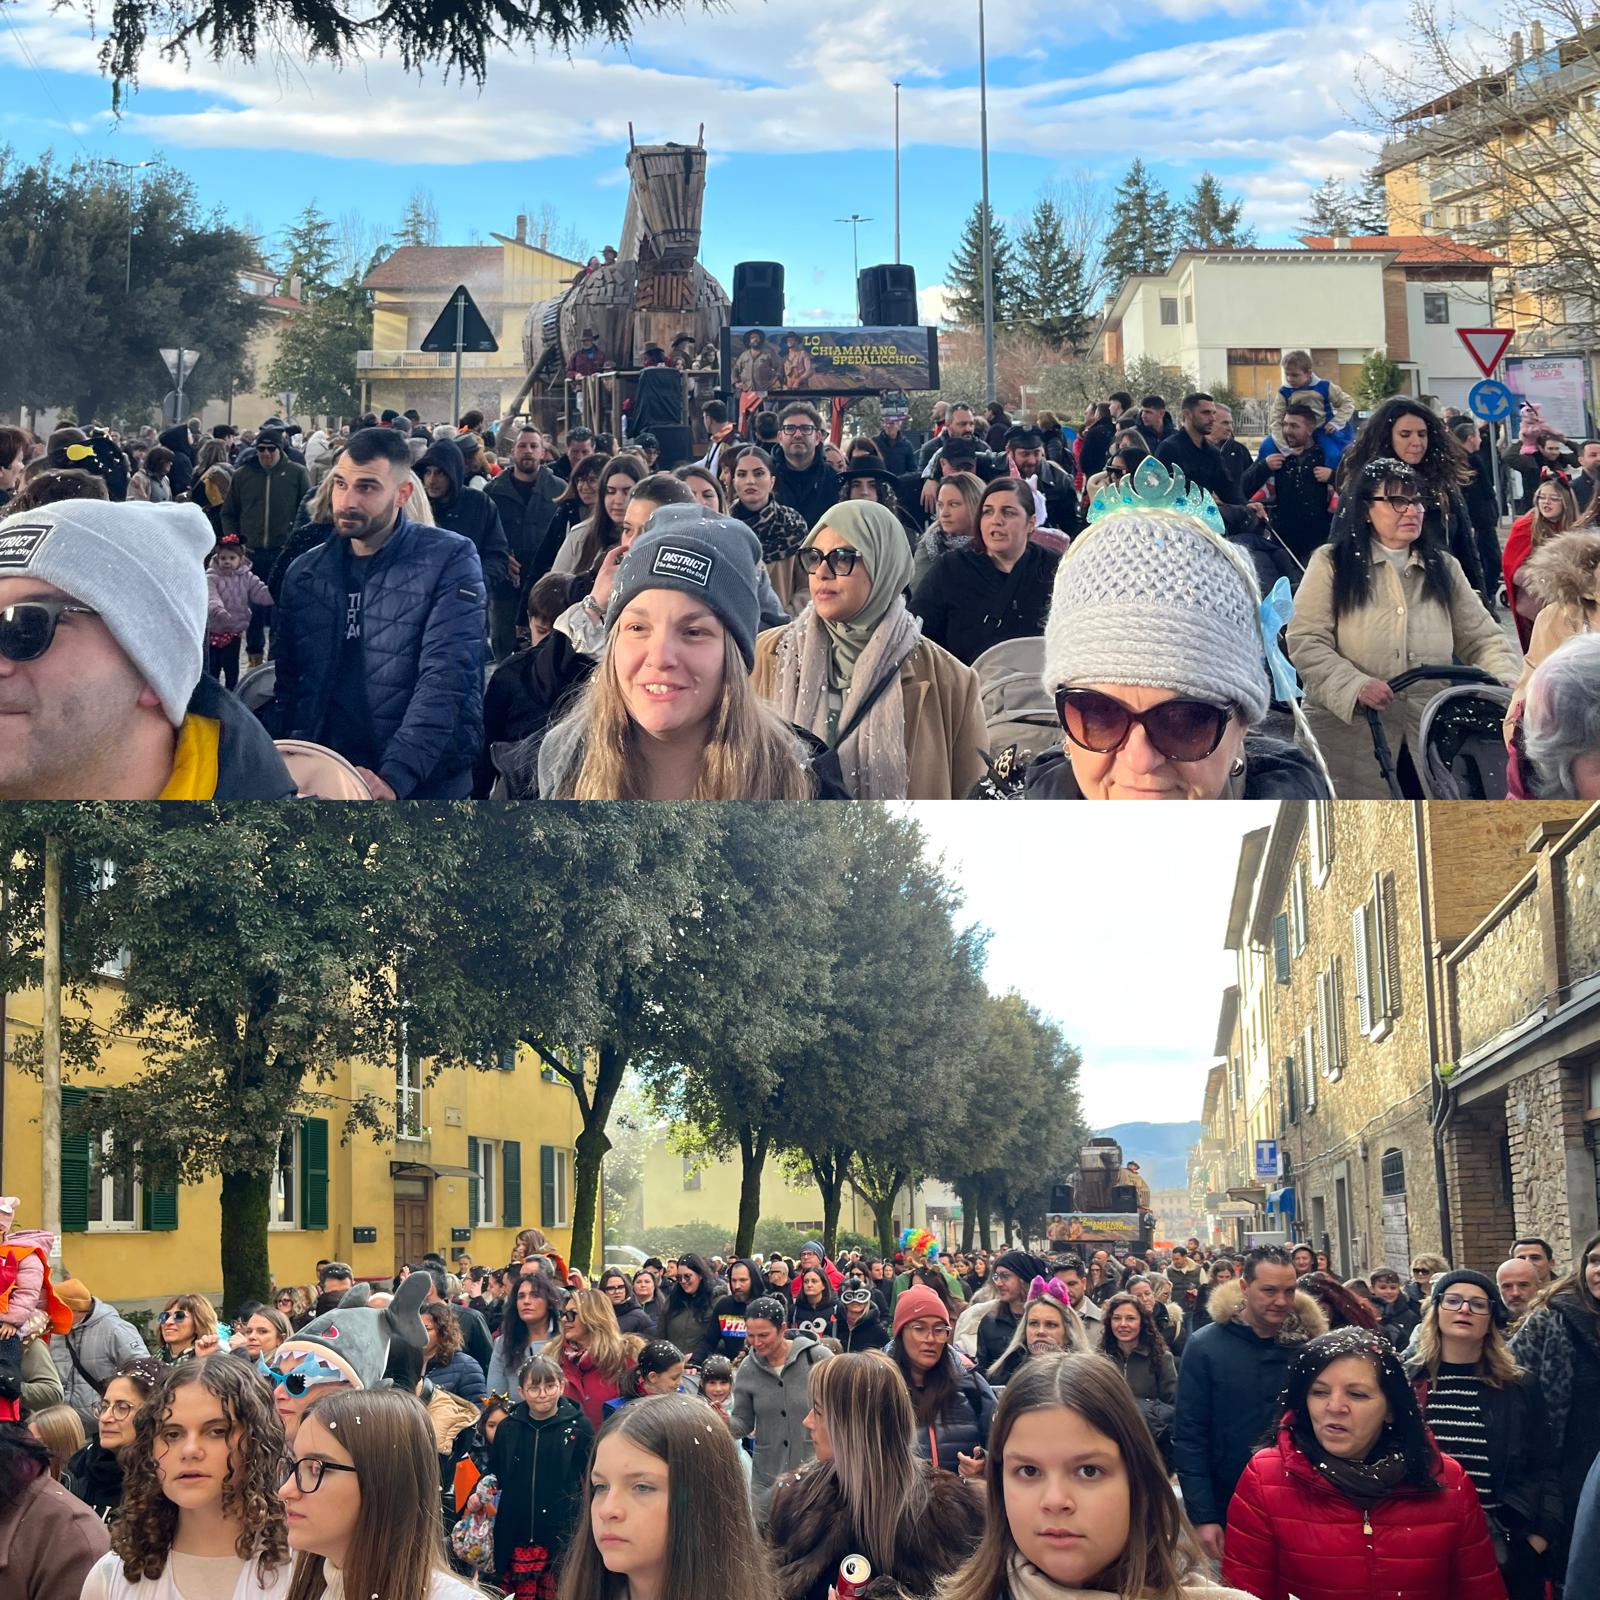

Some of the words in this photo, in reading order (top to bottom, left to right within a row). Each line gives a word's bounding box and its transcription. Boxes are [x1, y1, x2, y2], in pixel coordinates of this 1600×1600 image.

[803, 336, 820, 346] LO
[810, 346, 897, 356] CHIAMAVANO
[662, 552, 706, 571] DISTRICT
[686, 567, 695, 576] the
[1258, 1142, 1275, 1164] T
